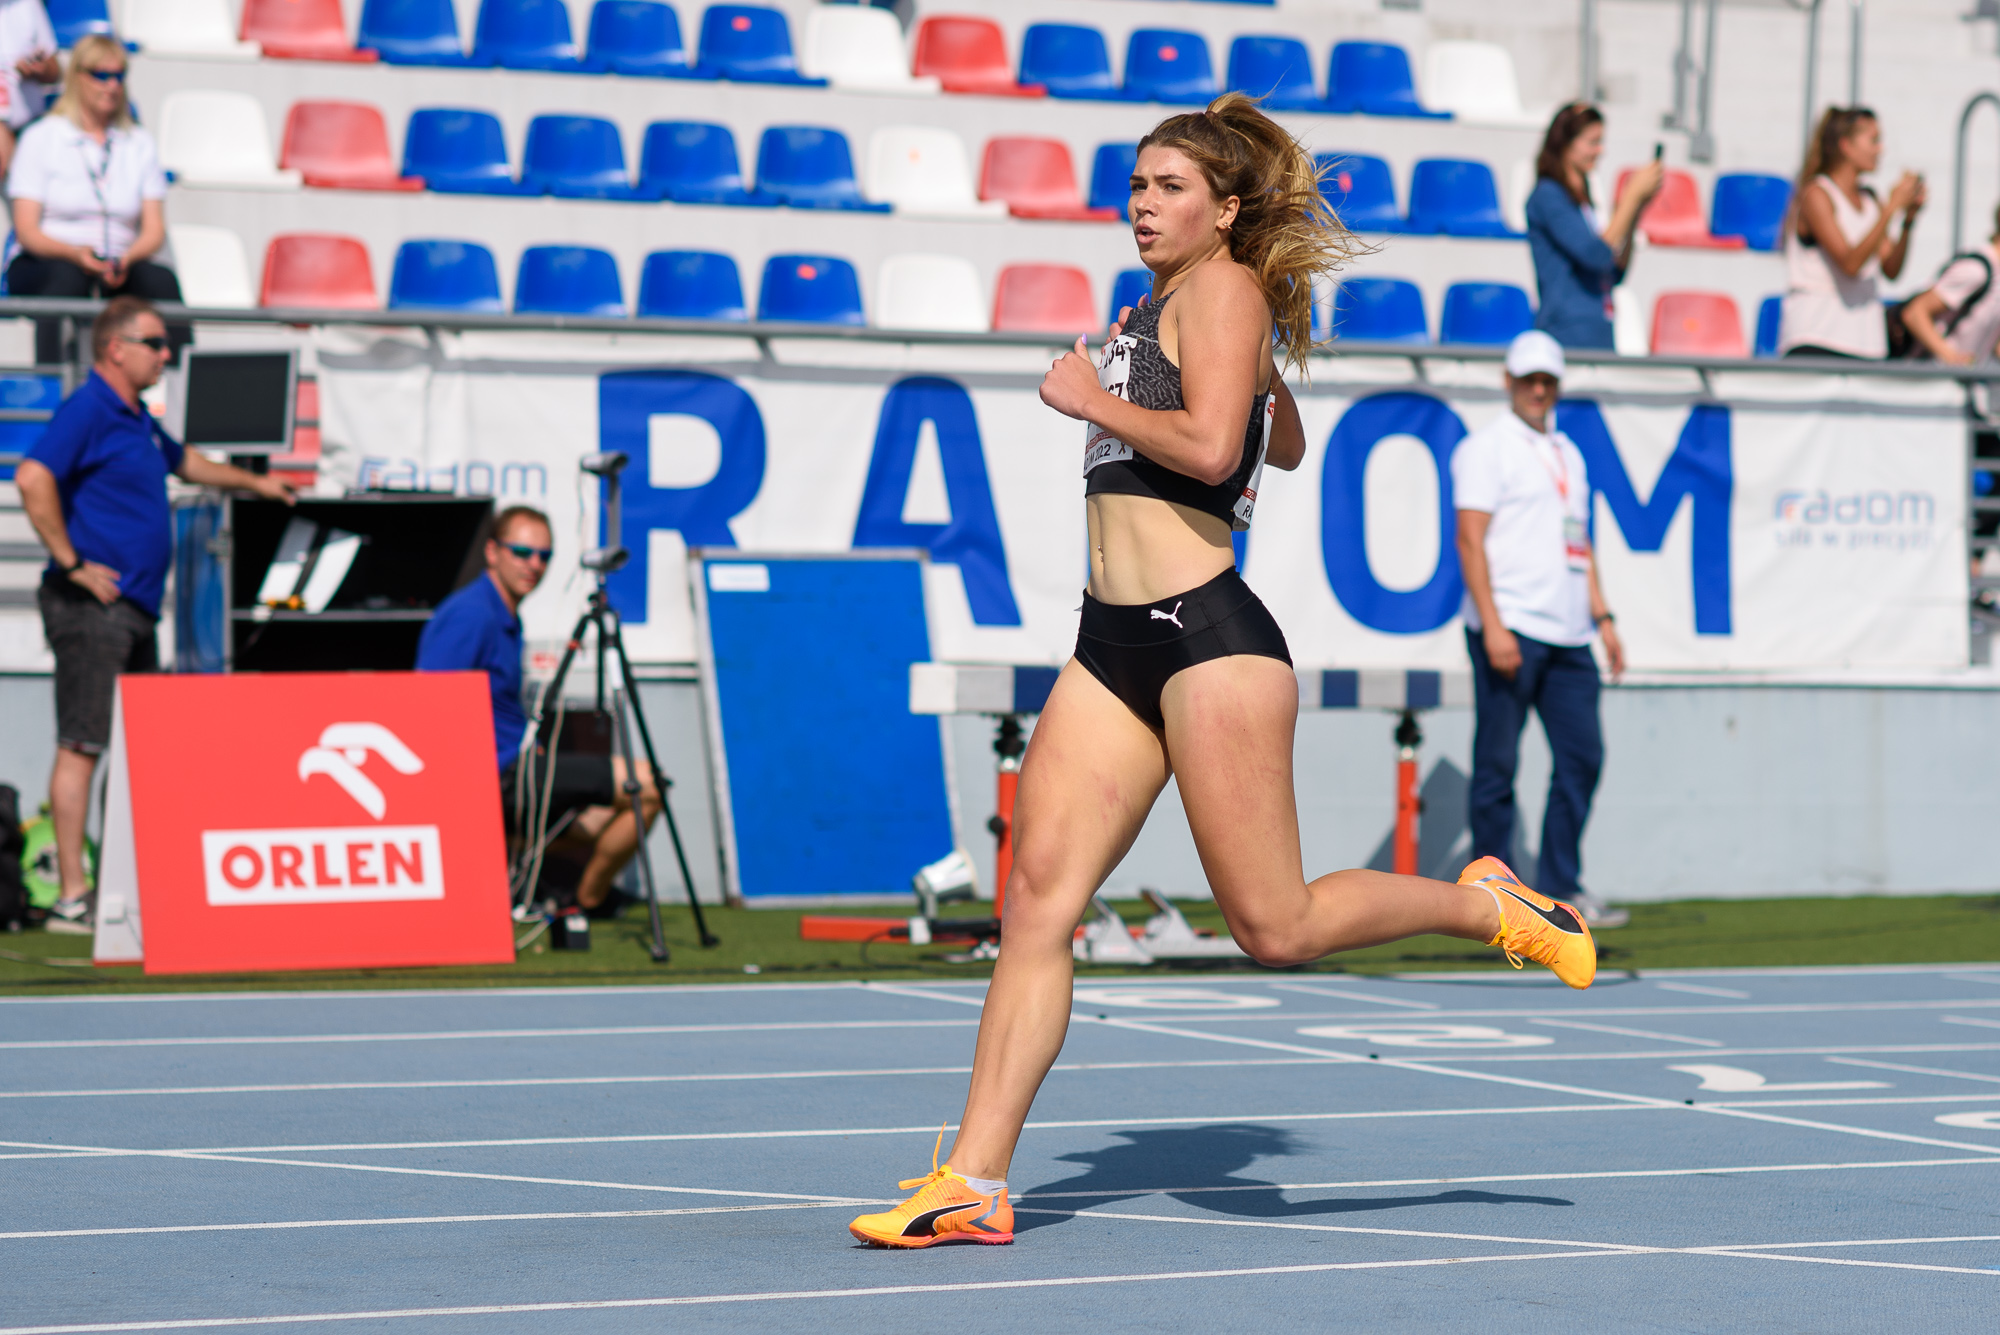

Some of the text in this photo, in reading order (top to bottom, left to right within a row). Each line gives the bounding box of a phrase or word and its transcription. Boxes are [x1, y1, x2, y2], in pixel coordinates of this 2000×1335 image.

[599, 368, 1734, 635] RAOM
[1774, 490, 1936, 525] radom
[221, 841, 425, 891] ORLEN
